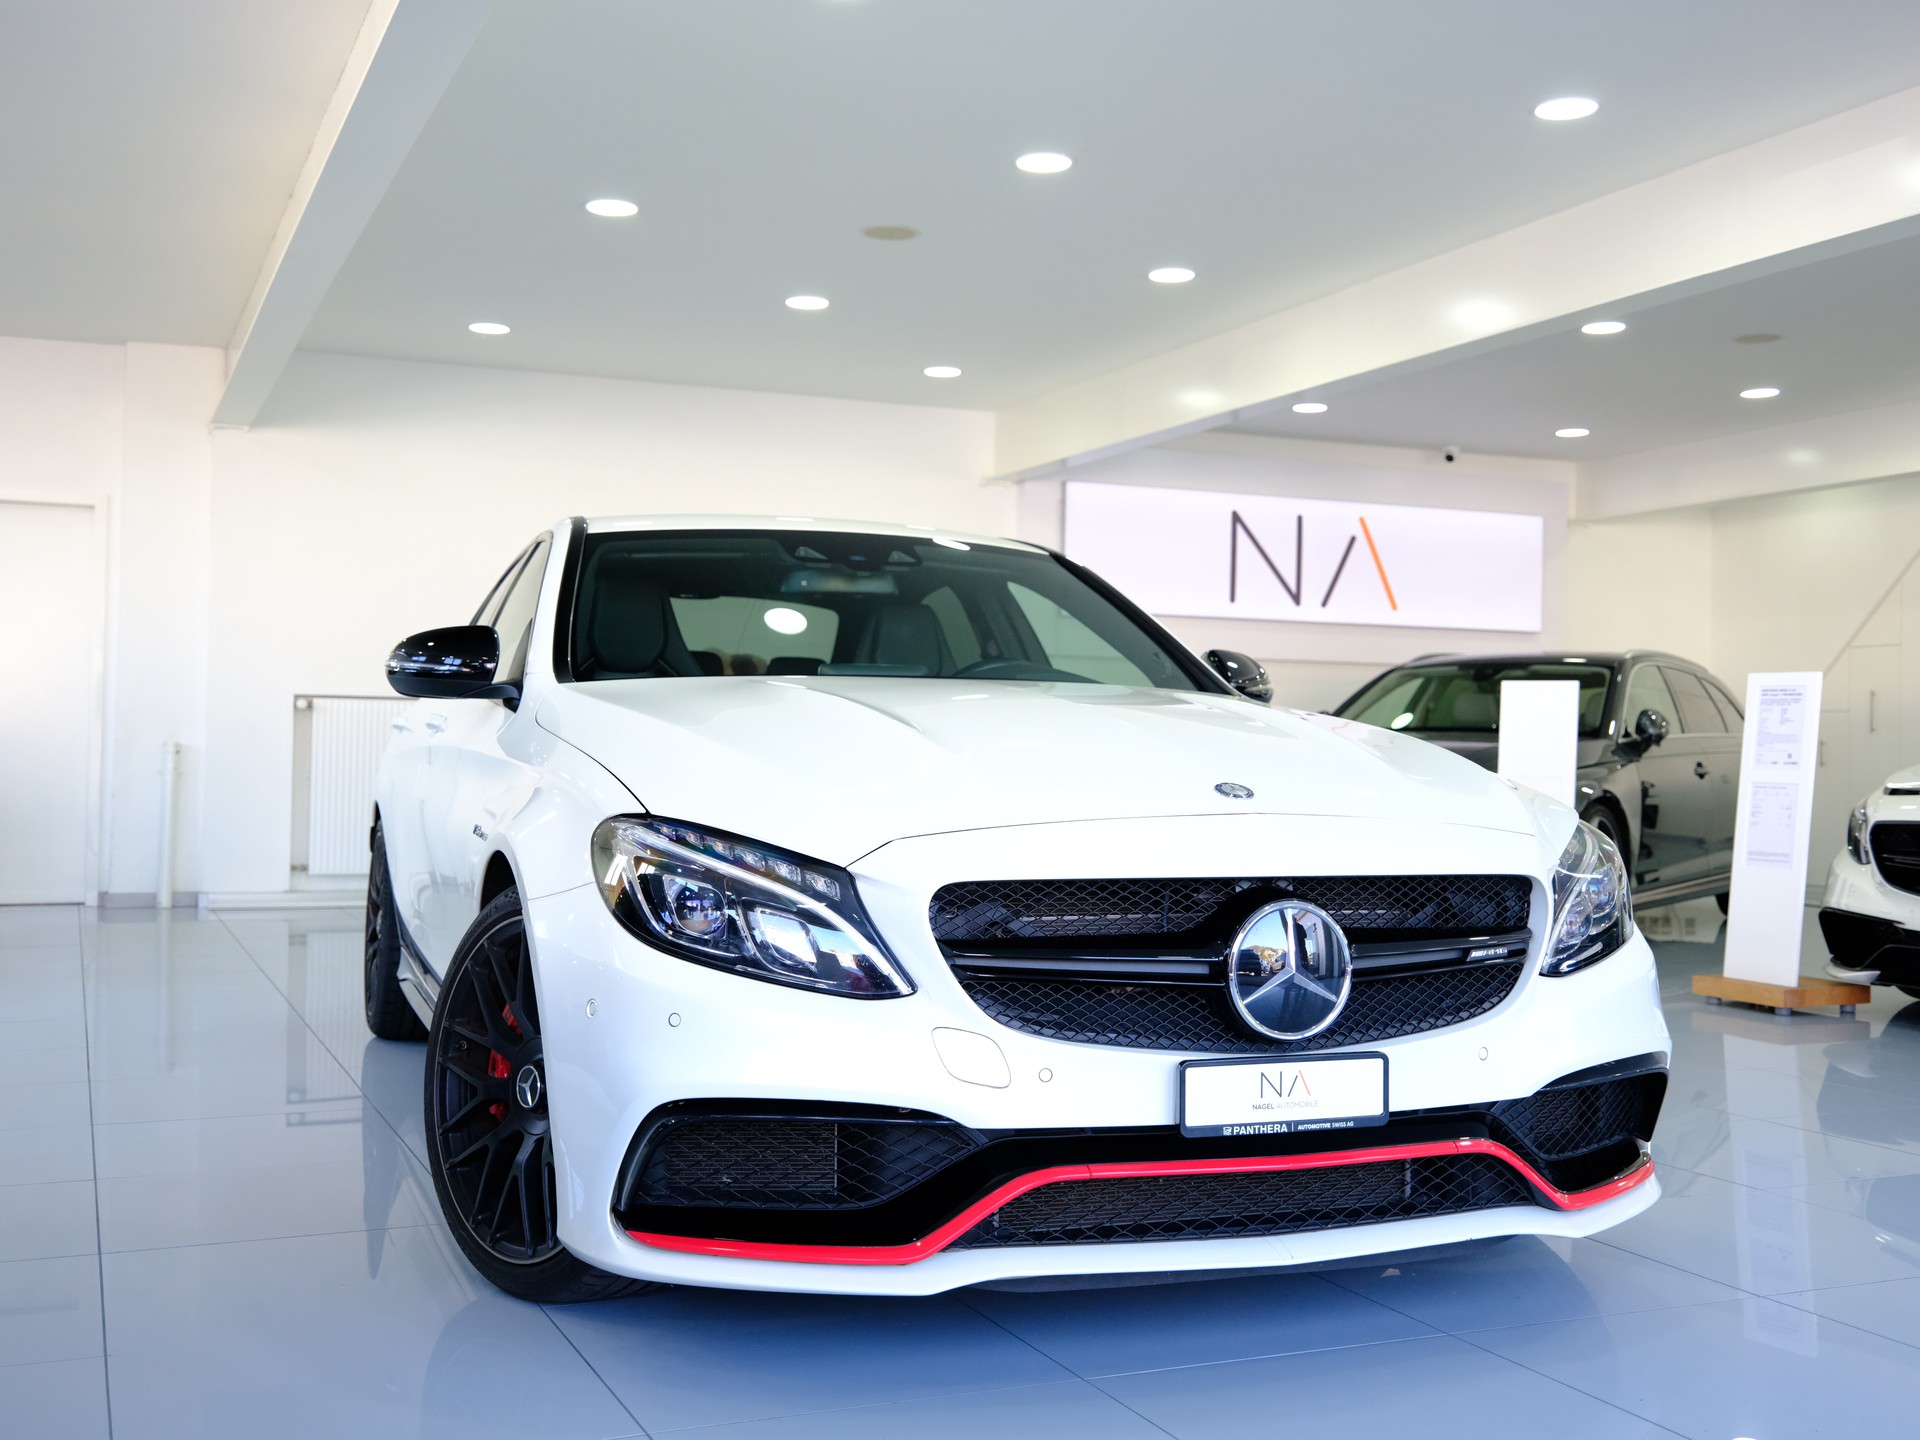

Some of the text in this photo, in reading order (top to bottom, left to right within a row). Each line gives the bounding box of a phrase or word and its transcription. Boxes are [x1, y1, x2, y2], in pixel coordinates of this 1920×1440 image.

[1276, 1100, 1319, 1109] AUTOMOBILE
[1233, 1123, 1288, 1136] PANTHERA
[1297, 1122, 1331, 1131] AUTOMOTIVE
